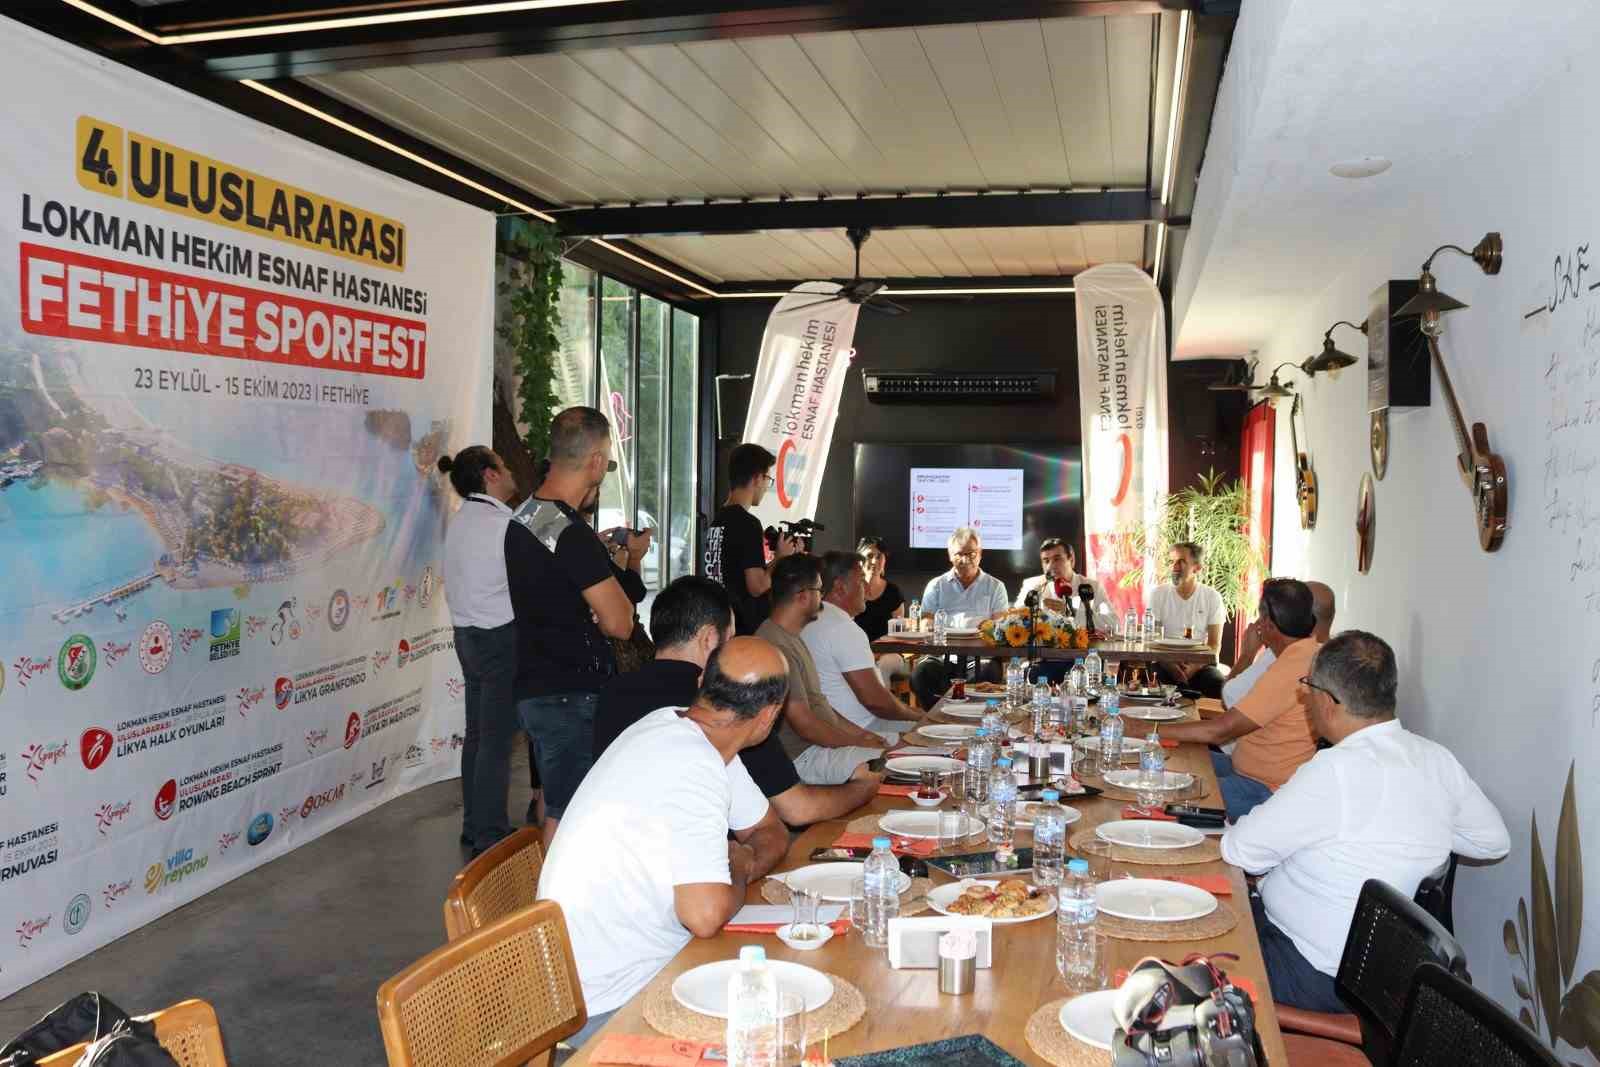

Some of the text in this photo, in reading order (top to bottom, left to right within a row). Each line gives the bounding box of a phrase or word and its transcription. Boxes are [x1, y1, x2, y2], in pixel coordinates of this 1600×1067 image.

[82, 127, 404, 267] 4. ULUSLARARASI
[22, 193, 164, 260] LOKMAN
[258, 252, 329, 293] ESNAF
[255, 301, 426, 371] SPORFEST
[134, 368, 153, 389] 23
[159, 368, 211, 393] EYLÜL
[225, 376, 240, 396] 15
[243, 375, 279, 398] EKİM
[282, 382, 312, 400] 2023
[802, 397, 819, 440] ESNAF
[117, 716, 148, 731] LOKMAN
[150, 729, 177, 748] HALK
[178, 715, 225, 739] OYUNLARI
[220, 773, 252, 796] BEACH
[252, 762, 283, 781] SPRINT
[0, 849, 58, 882] RNUVASI
[167, 848, 193, 871] villa
